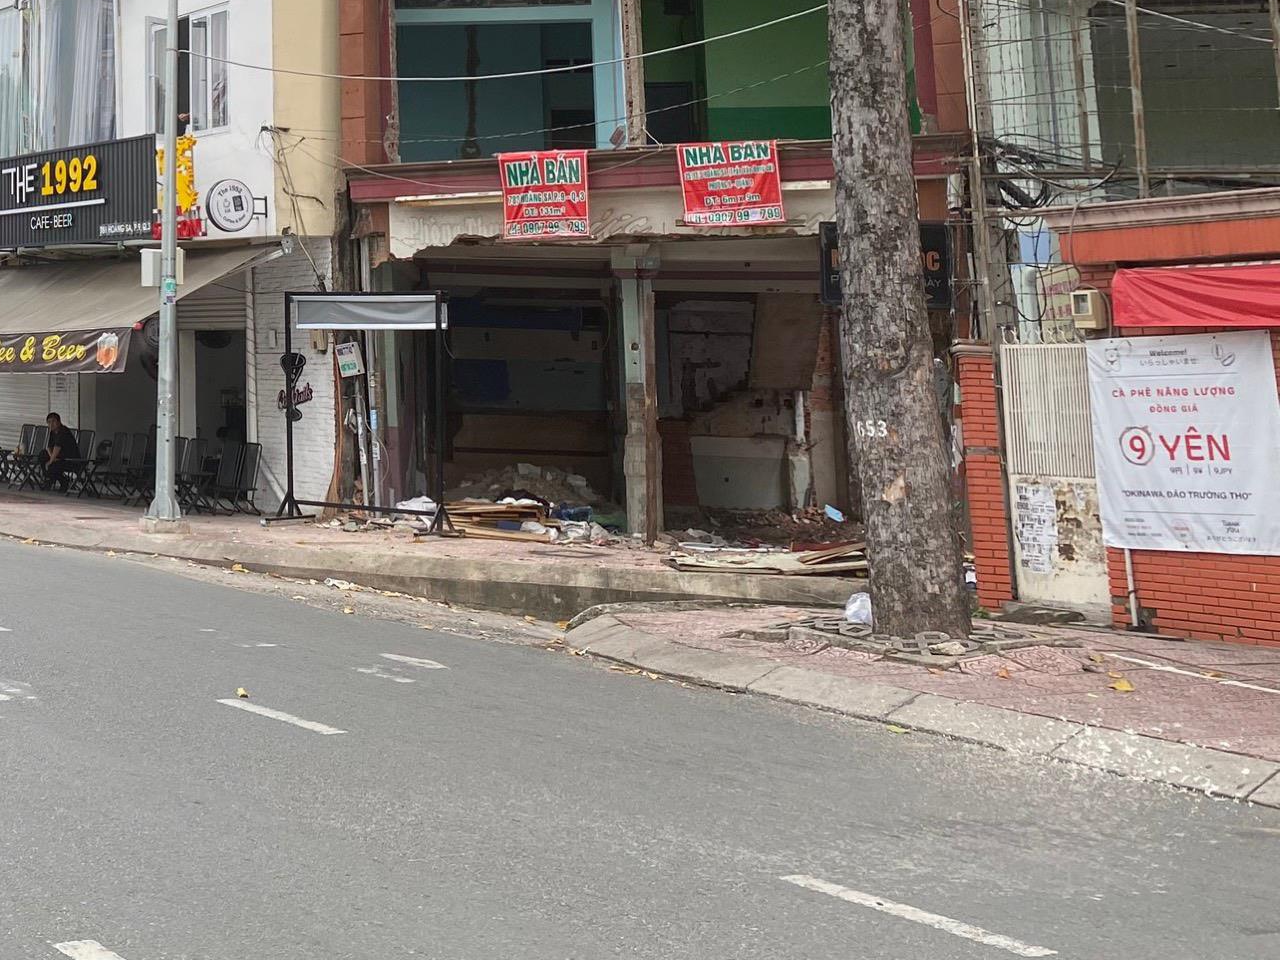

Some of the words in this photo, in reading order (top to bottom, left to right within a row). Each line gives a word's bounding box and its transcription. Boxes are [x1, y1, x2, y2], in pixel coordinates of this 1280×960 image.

[2, 163, 37, 203] THE
[41, 154, 97, 196] 1992
[505, 155, 541, 187] NHÀ
[545, 153, 580, 184] BÁN
[30, 214, 73, 230] CAFE-BEER
[20, 336, 35, 361] &
[42, 335, 87, 361] Beer
[1149, 349, 1187, 357] Welcome!
[1131, 386, 1151, 397] PHÊ
[1194, 386, 1235, 398] LƯỢNG
[857, 420, 888, 437] 653
[1129, 435, 1145, 460] 9
[1159, 426, 1231, 461] YÊN
